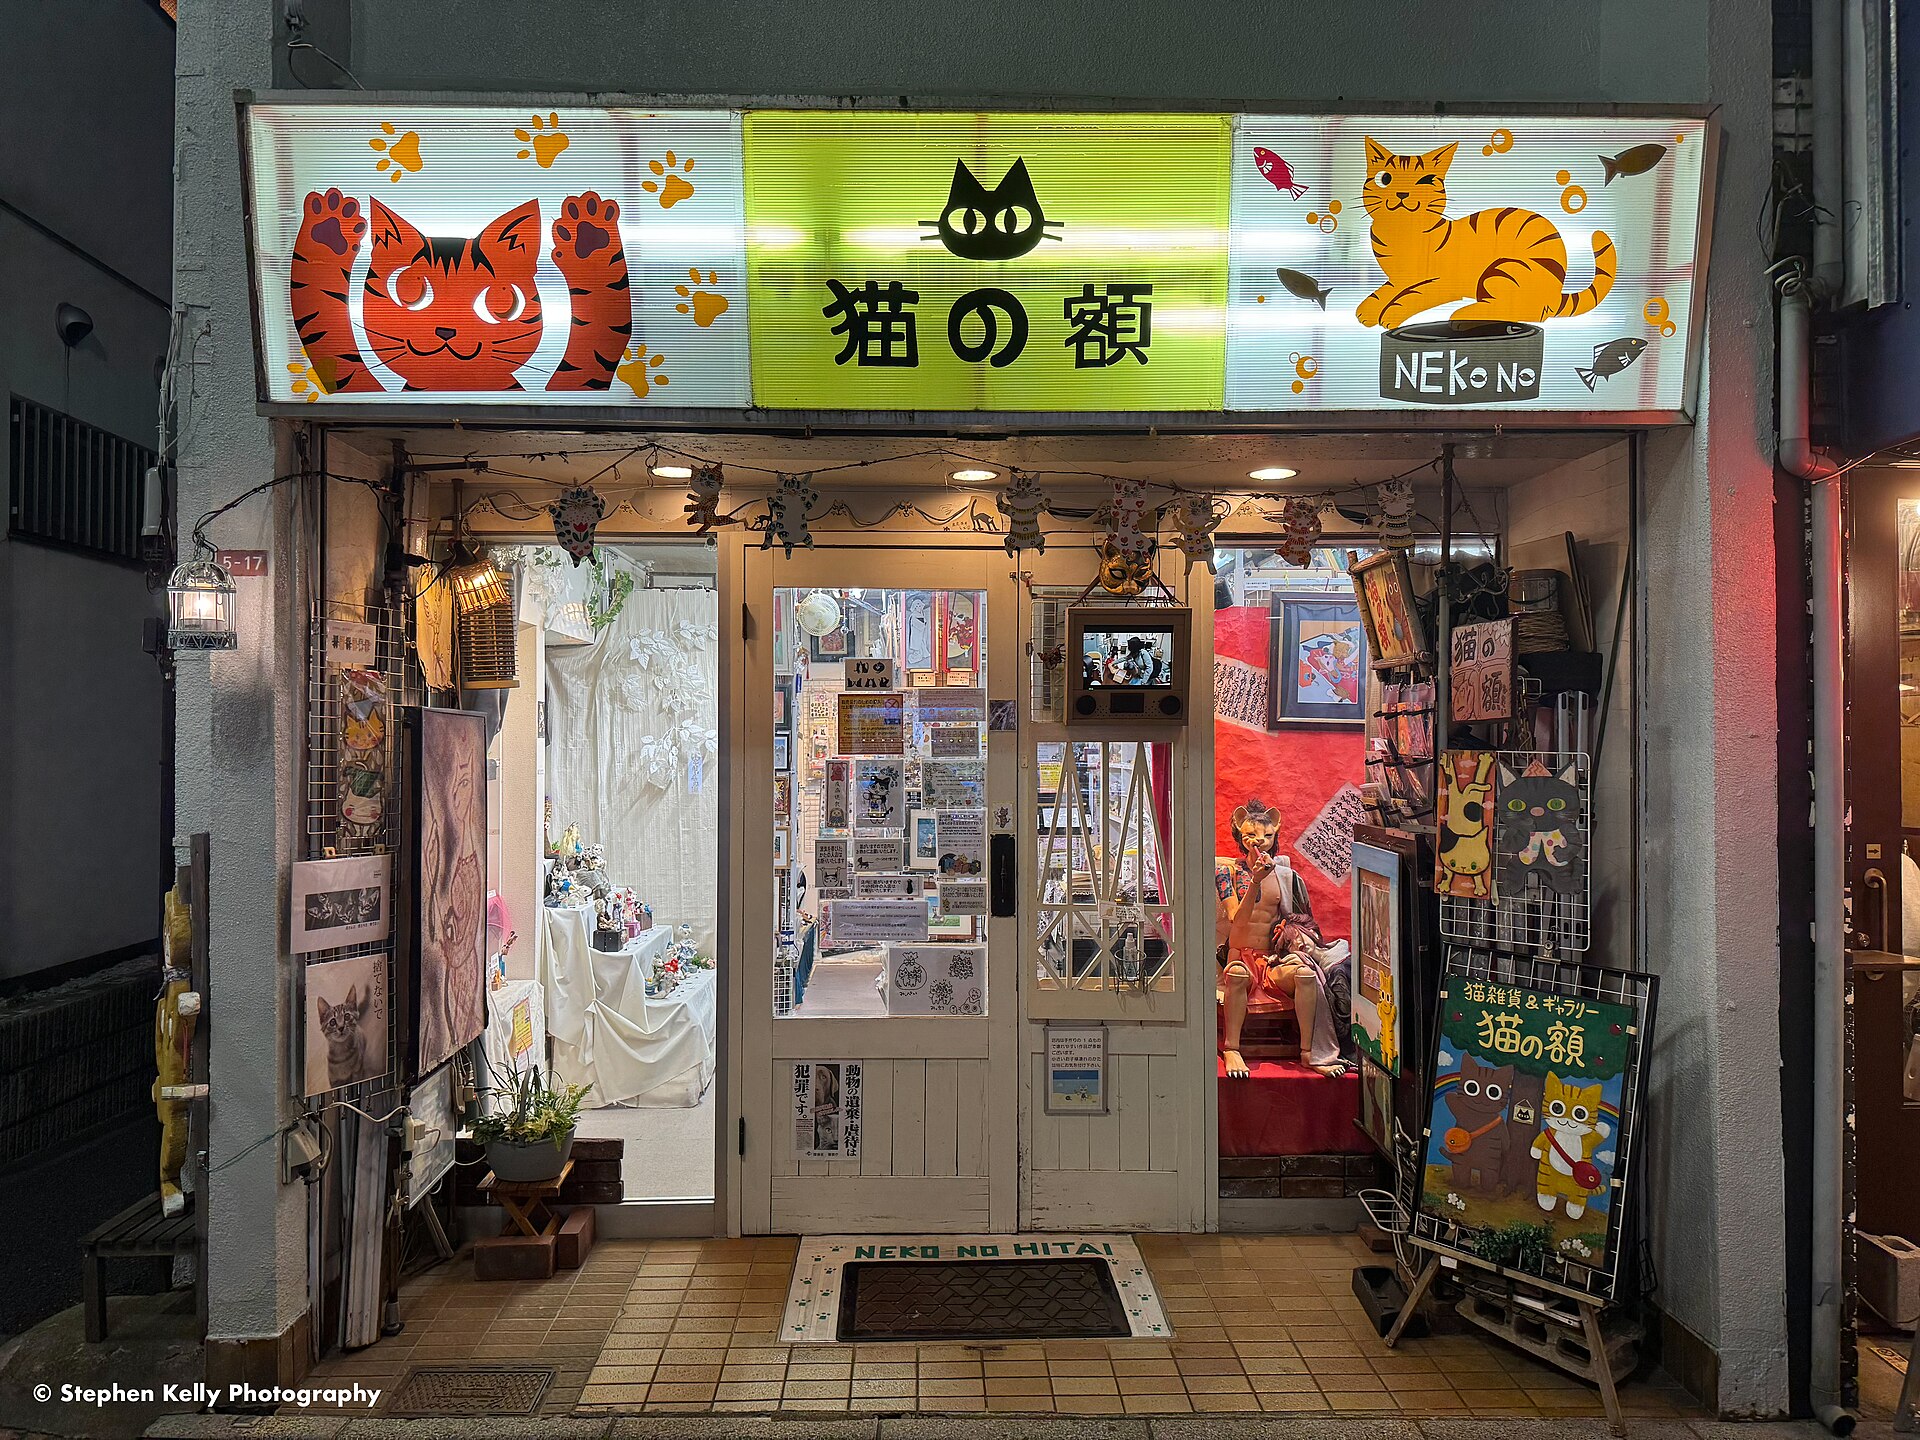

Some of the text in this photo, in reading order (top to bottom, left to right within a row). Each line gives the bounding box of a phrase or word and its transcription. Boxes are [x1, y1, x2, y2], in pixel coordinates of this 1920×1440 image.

[822, 279, 1153, 369] 猫の額
[223, 556, 262, 570] 5-17
[373, 959, 383, 1020] 捨てないで
[1475, 1010, 1586, 1068] 猫の額
[794, 1064, 810, 1118] 犯罪です。
[854, 1242, 1114, 1259] NEKO NO HITAI
